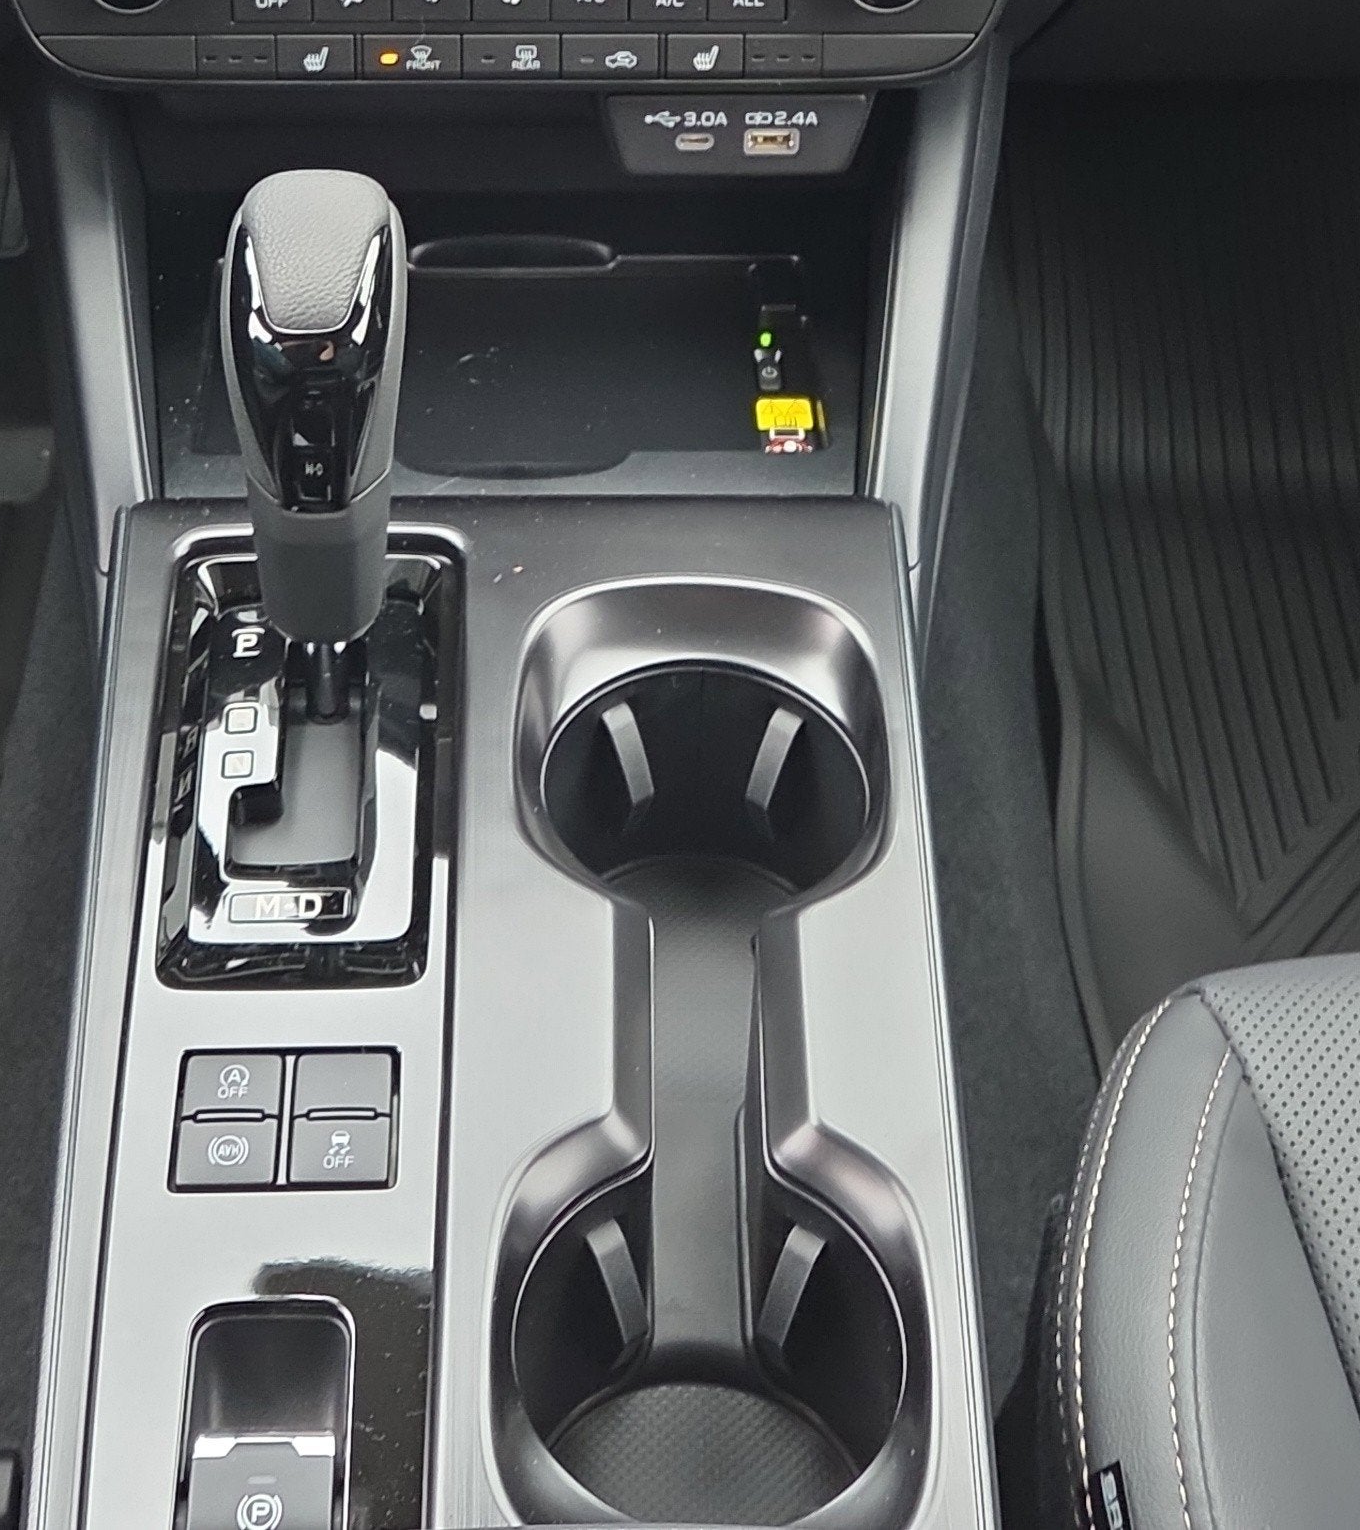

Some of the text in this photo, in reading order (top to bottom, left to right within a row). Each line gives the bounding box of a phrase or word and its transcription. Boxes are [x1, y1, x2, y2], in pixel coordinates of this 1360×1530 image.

[405, 59, 441, 71] FRONT
[511, 59, 541, 71] REAR
[683, 111, 819, 128] 3.0A 2.4A
[253, 892, 323, 919] M D
[217, 1085, 249, 1099] OFF
[322, 1154, 355, 1170] OFF
[251, 1502, 271, 1522] P
